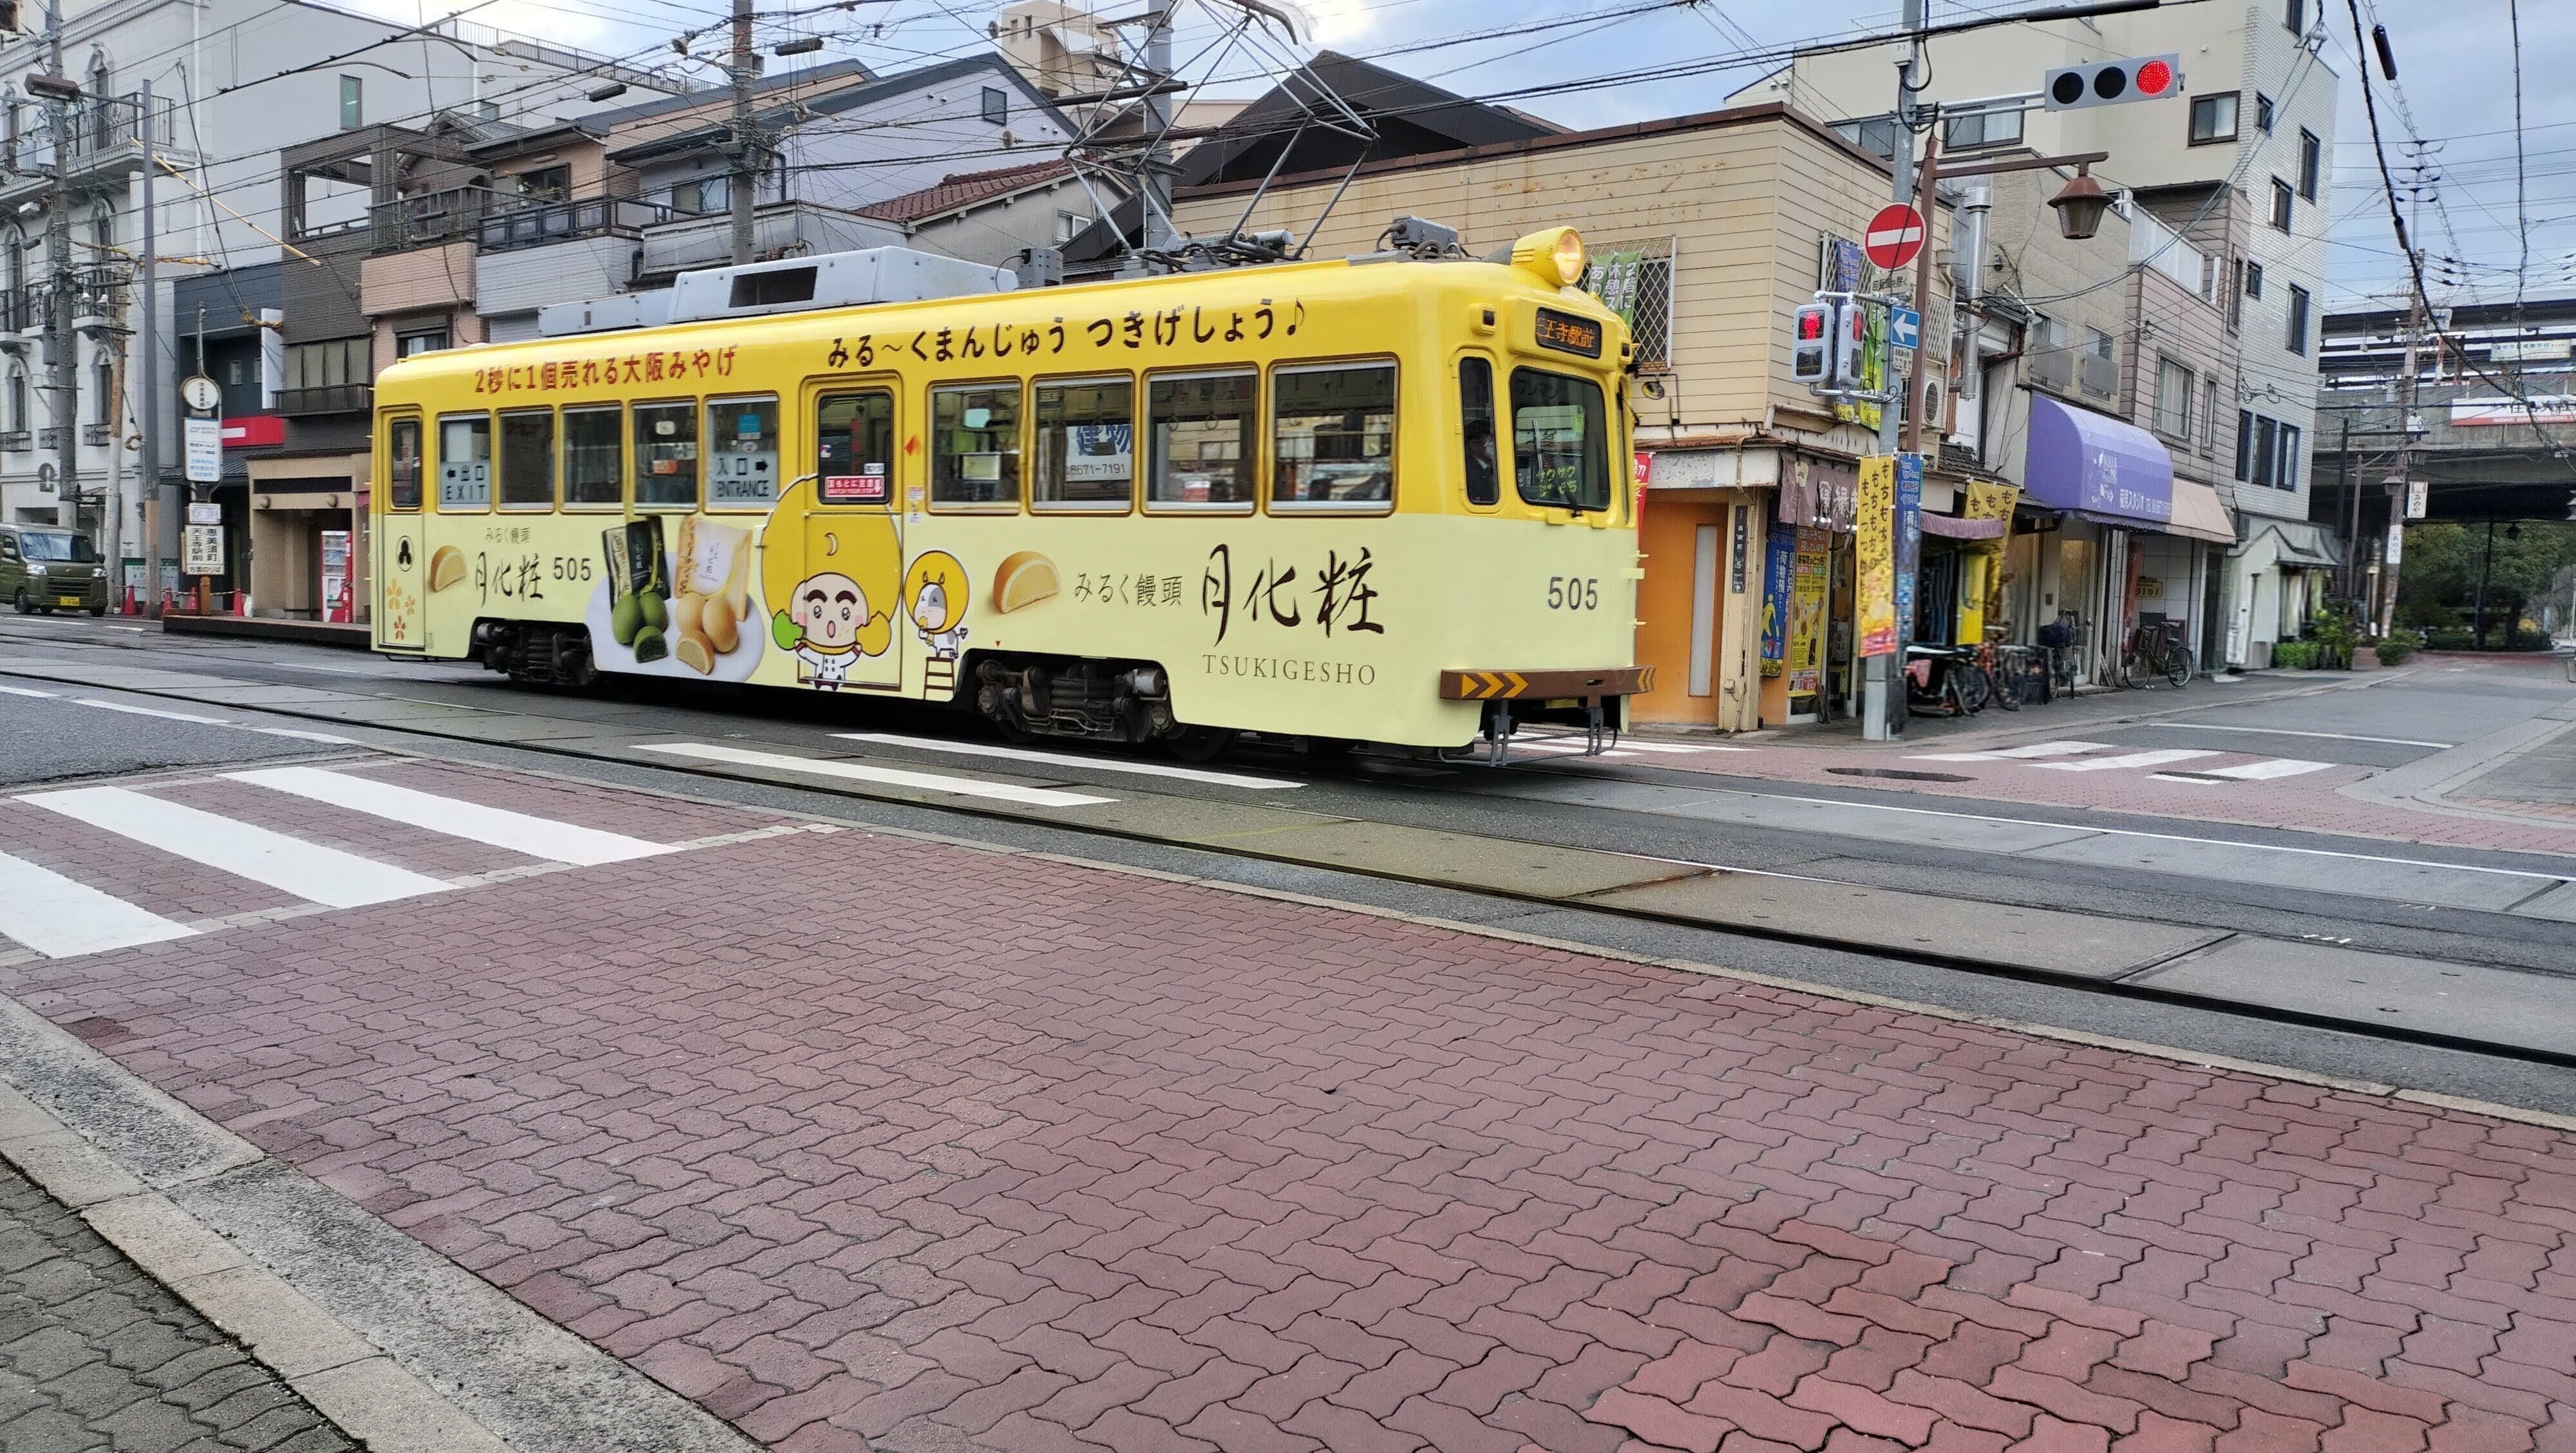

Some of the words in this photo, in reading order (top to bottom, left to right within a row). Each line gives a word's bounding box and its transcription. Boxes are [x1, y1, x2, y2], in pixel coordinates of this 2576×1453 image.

[1619, 261, 1636, 310] 2階に
[475, 343, 738, 395] 2秒に1個売れる大阪みやげ
[460, 464, 485, 482] 出口
[717, 457, 748, 475] 入口
[445, 485, 485, 500] EXIT
[717, 480, 769, 497] ENTRANCE
[191, 528, 204, 562] 天王寺駅前
[207, 529, 218, 562] 恵美須町
[475, 551, 544, 608] 月化粧
[553, 556, 591, 582] 505
[1074, 572, 1184, 607] みるく饅頭
[1202, 543, 1385, 648] 月化粧
[1548, 576, 1598, 611] 505
[1202, 654, 1376, 685] TSUKIGESHO
